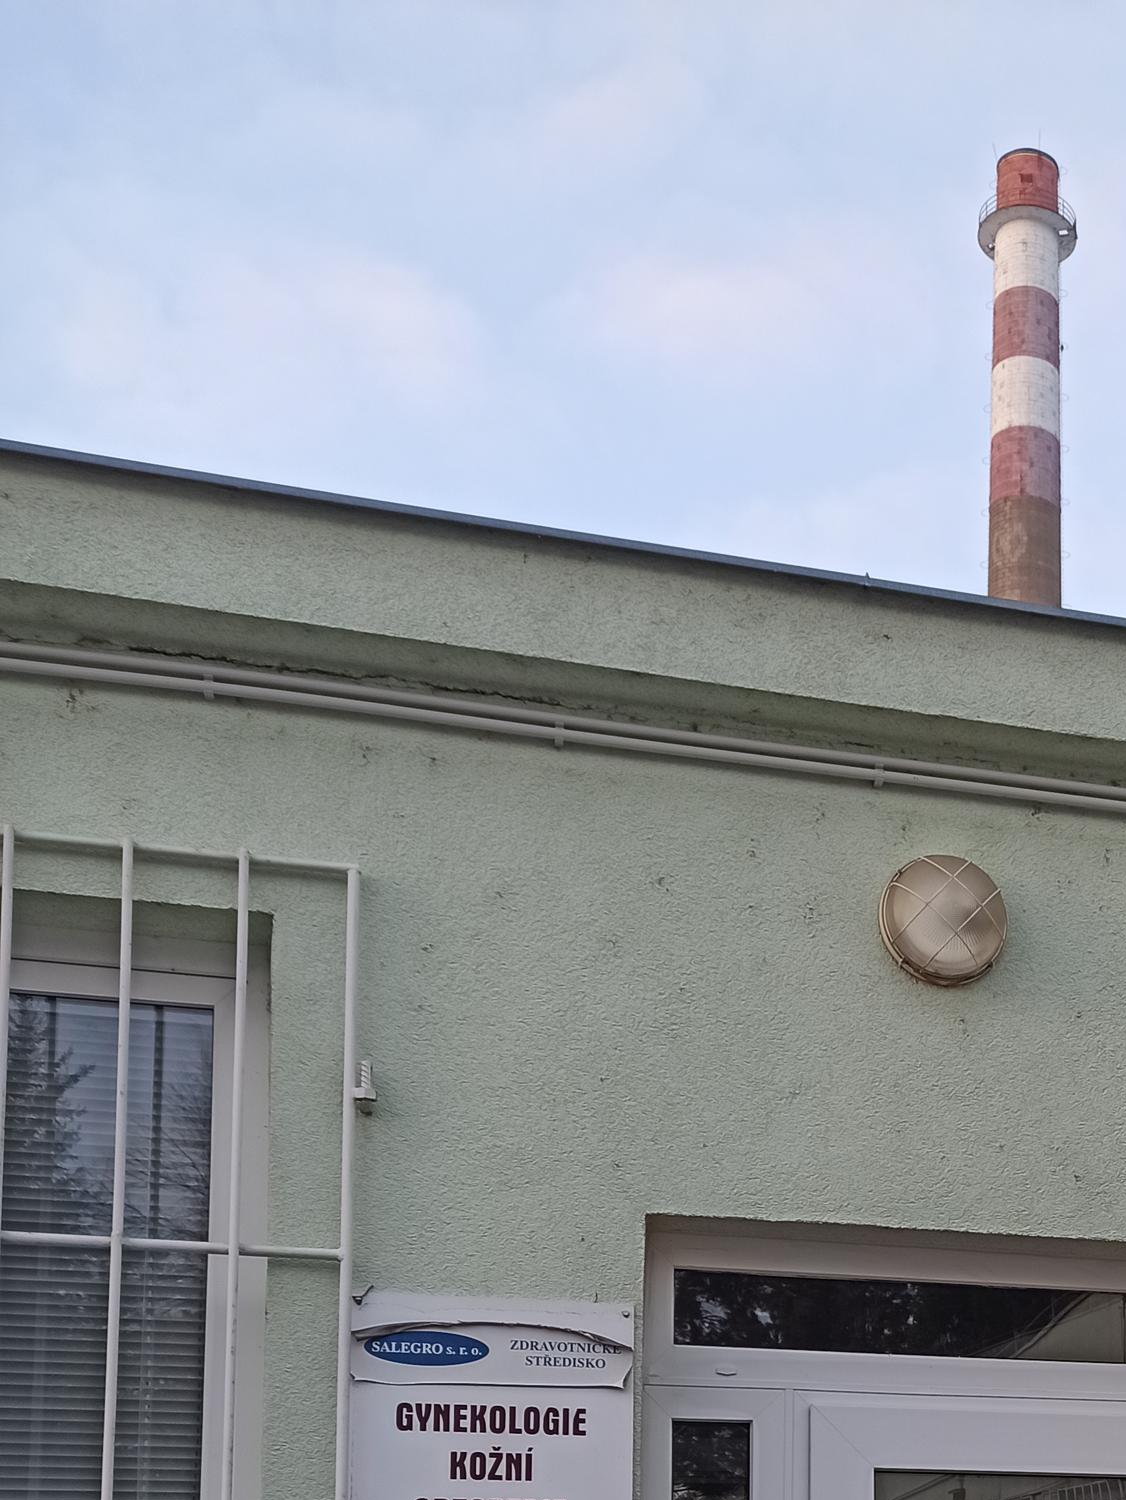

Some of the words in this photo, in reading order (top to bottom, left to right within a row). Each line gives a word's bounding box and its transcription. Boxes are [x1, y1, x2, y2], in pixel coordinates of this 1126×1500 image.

[371, 1341, 444, 1355] SALEGRO
[446, 1346, 456, 1355] s.
[459, 1346, 468, 1356] r.
[471, 1347, 482, 1356] o.
[525, 1355, 605, 1368] STŘEDISKO
[396, 1403, 586, 1436] GYNEKOLOGIE
[450, 1447, 533, 1481] KOŽNÍ
